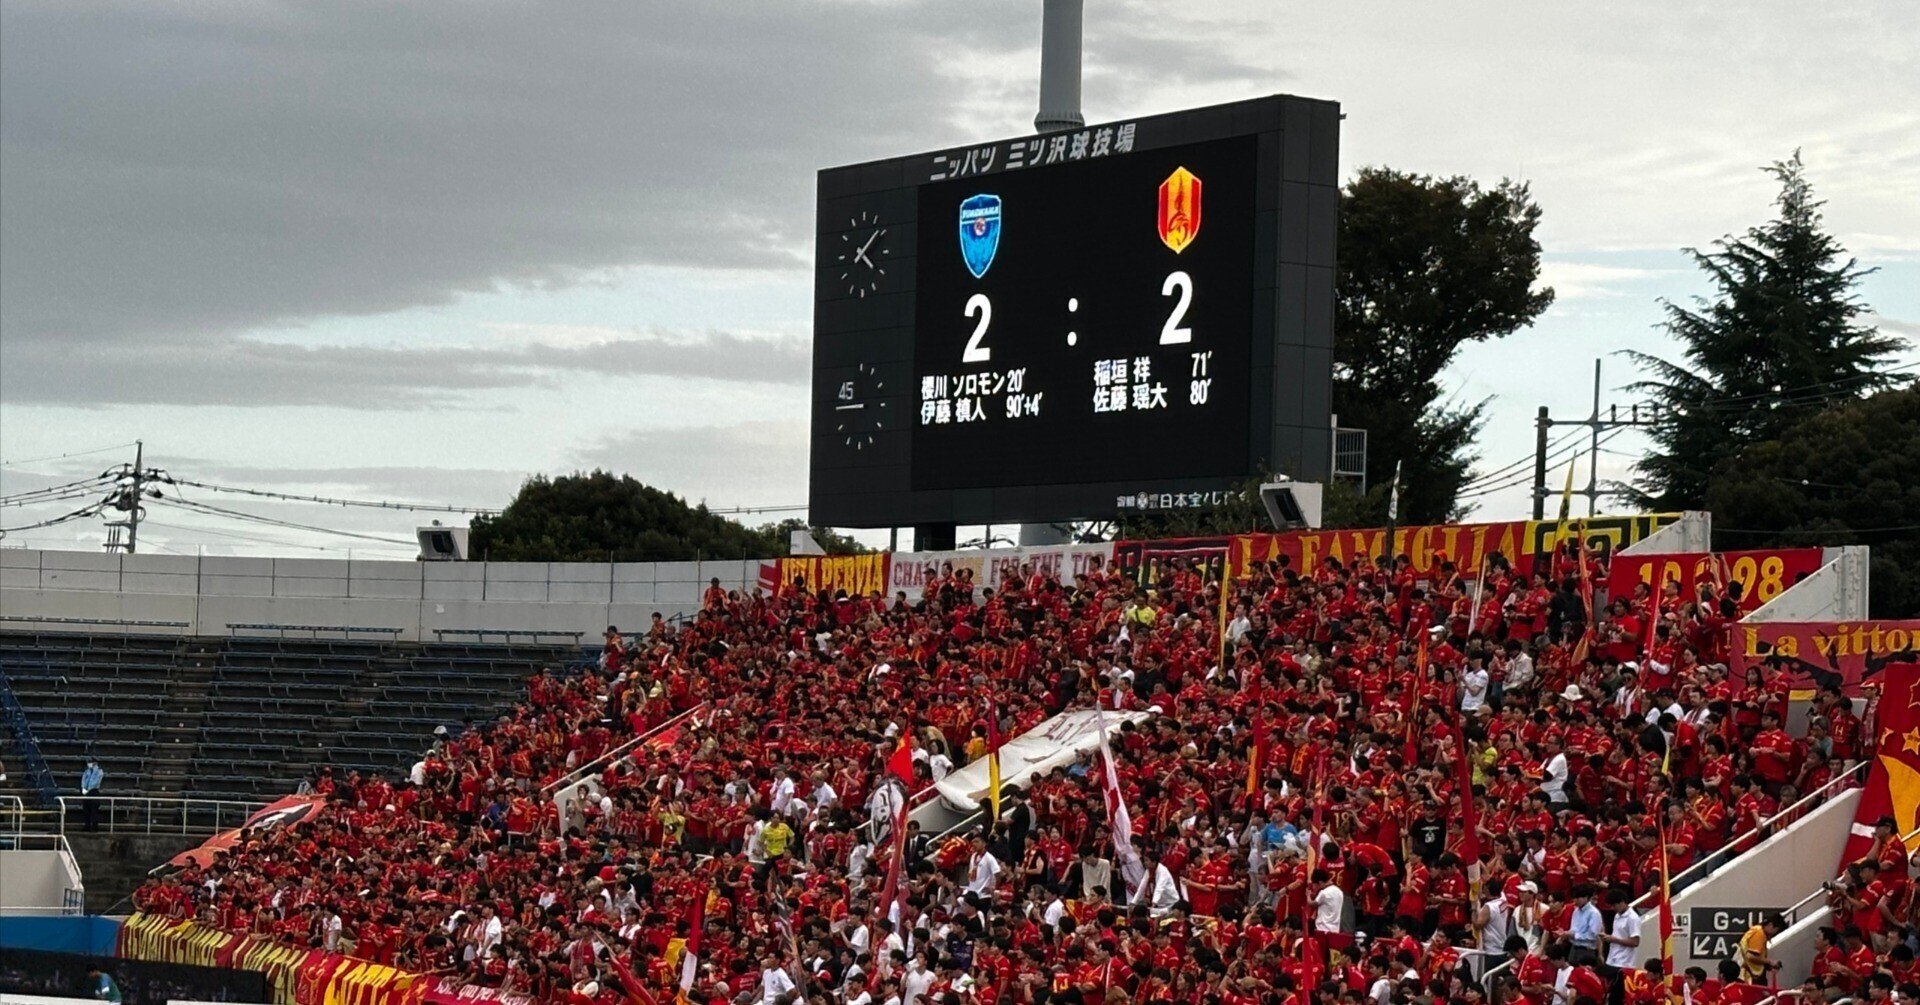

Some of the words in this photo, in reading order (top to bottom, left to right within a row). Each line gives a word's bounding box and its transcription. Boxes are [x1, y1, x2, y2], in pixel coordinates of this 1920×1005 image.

[930, 146, 996, 181] ニッパツ
[1005, 122, 1136, 170] 三ツ沢球技場
[962, 293, 992, 363] 2
[1159, 271, 1193, 345] 2
[953, 372, 1005, 397] ソロモン
[1093, 359, 1128, 386] 稲垣
[1133, 356, 1151, 383] 祥
[838, 381, 854, 400] 45
[1093, 385, 1127, 413] 佐藤
[920, 399, 951, 425] 伊藤
[1298, 524, 1517, 578] FAMIGLIA
[1731, 555, 1785, 603] 98
[1742, 626, 1799, 658] La
